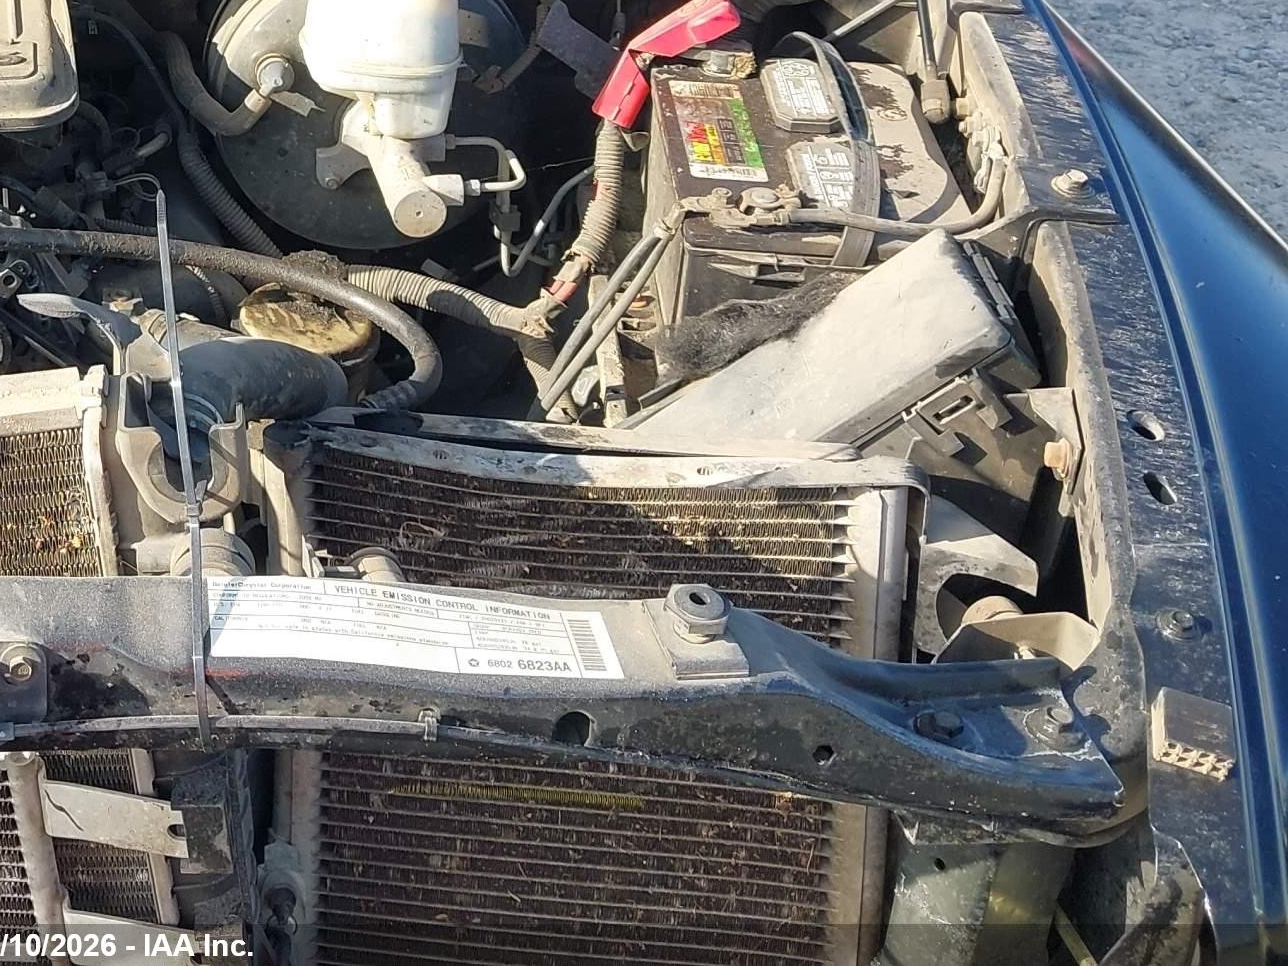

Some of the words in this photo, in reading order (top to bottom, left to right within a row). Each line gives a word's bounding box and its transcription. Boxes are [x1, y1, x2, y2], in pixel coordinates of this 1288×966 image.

[334, 585, 377, 597] VEHICLE
[382, 590, 432, 606] EMISSION
[435, 599, 478, 612] CONTROL
[485, 605, 551, 621] INFORMATION
[487, 658, 512, 669] 6802
[518, 659, 572, 673] 6823AA
